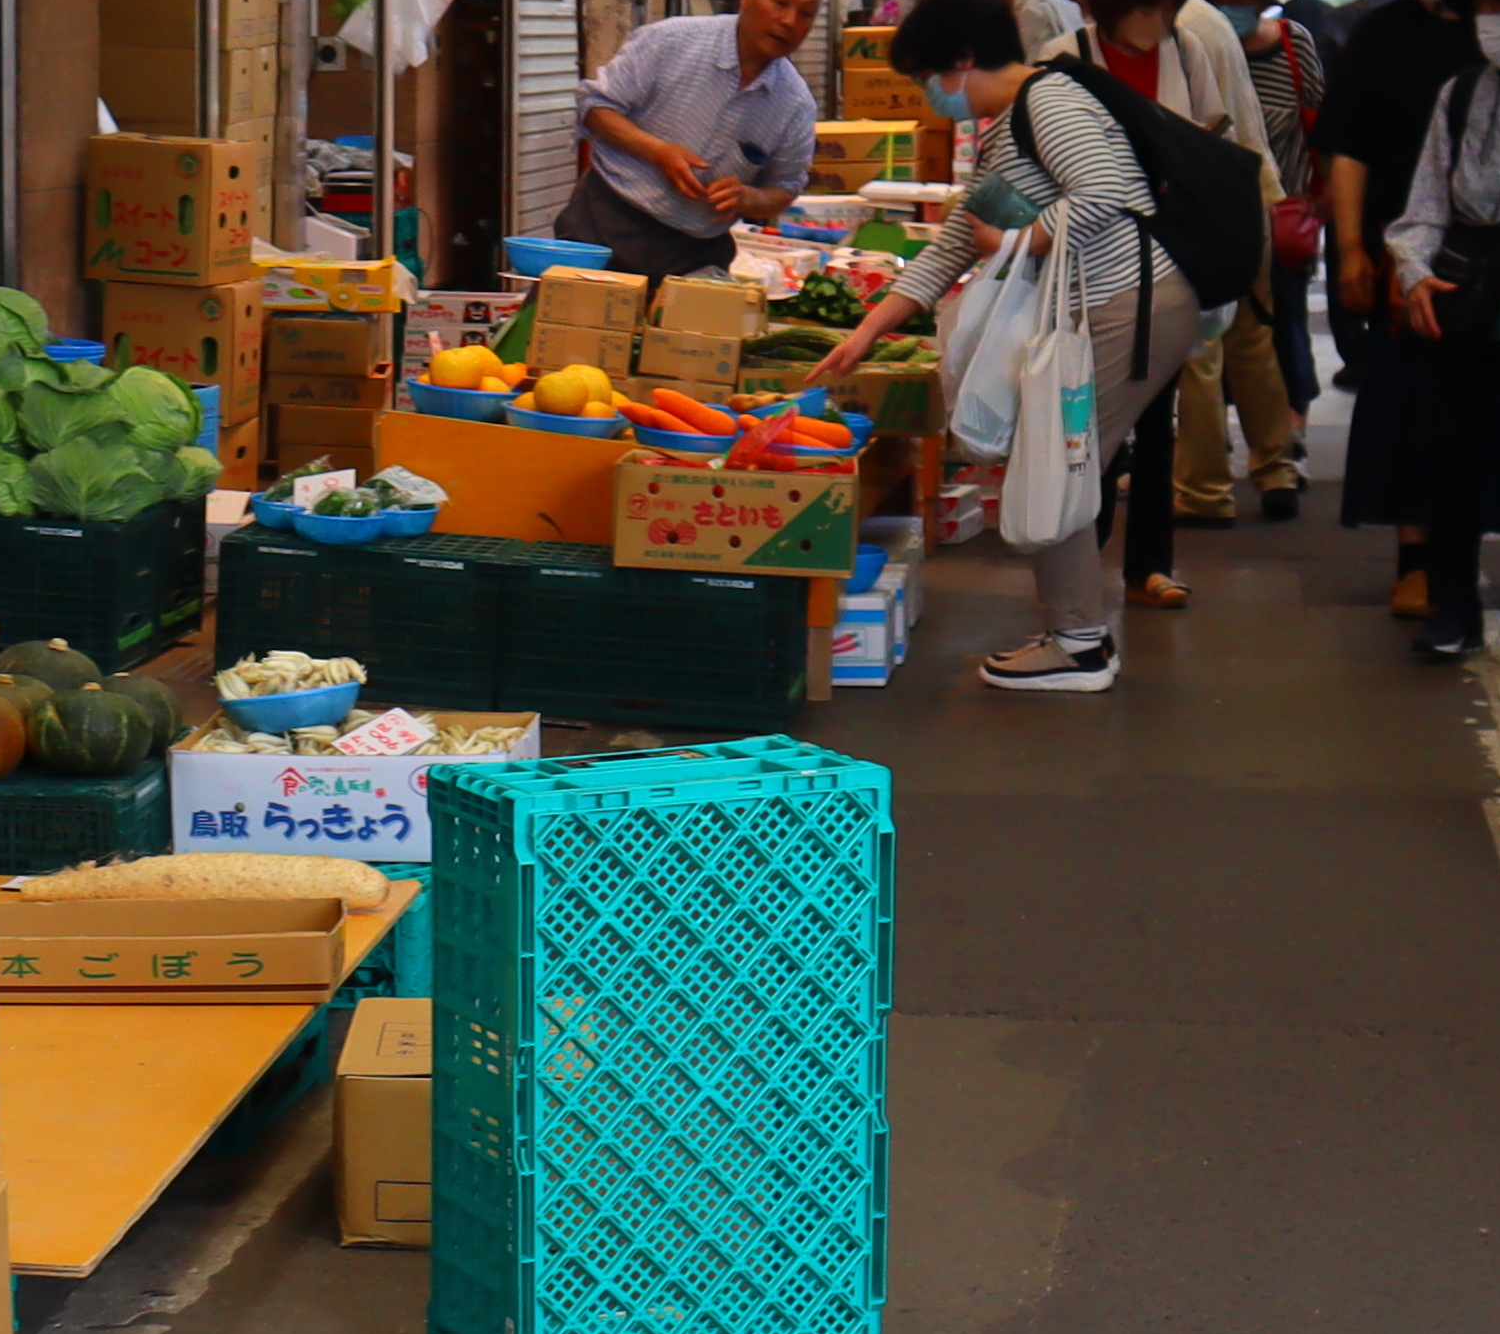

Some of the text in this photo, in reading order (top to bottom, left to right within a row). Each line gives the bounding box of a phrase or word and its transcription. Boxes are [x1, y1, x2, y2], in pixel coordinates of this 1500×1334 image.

[112, 201, 176, 227] スイート
[135, 241, 190, 267] コーン
[692, 501, 784, 531] さといも
[190, 802, 412, 841] 鳥取 らっきょう
